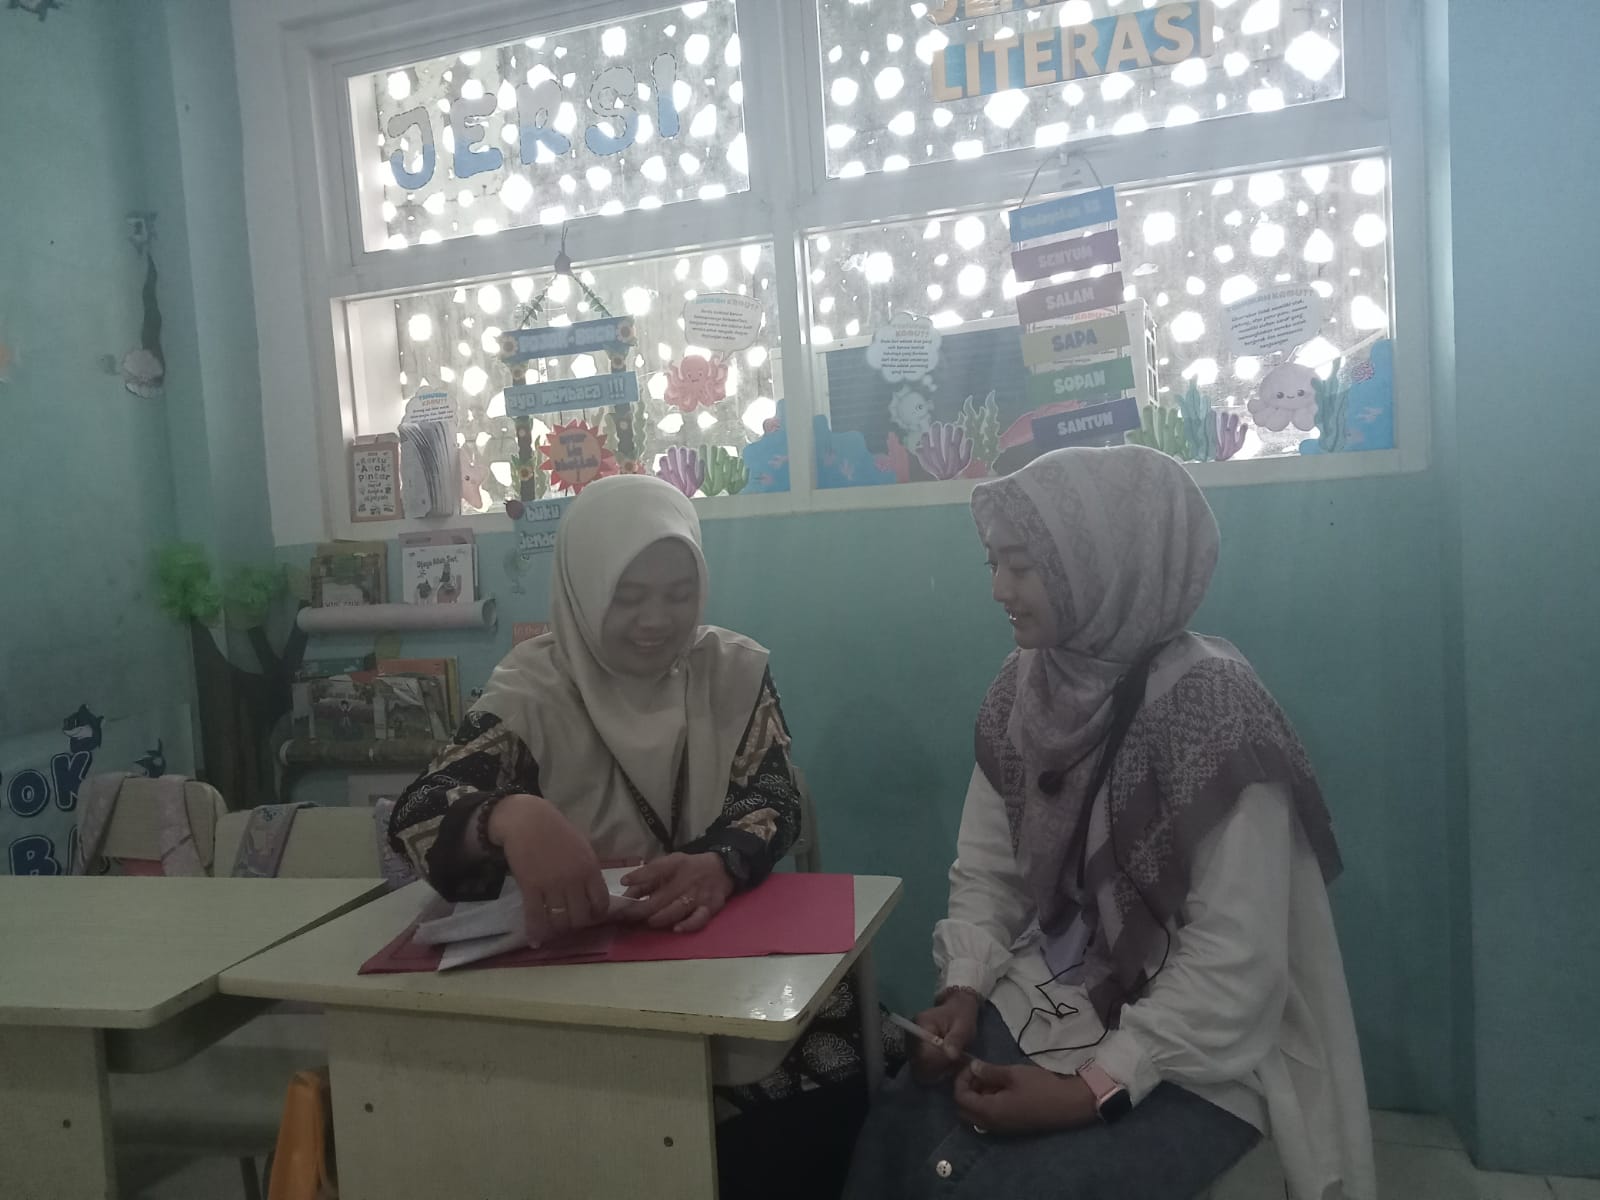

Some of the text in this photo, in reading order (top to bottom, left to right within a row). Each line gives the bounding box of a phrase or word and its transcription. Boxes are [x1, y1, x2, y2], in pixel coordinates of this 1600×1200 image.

[932, 0, 1214, 102] LITERASI
[386, 52, 680, 191] JERSI
[1038, 245, 1093, 268] SENYUM
[1045, 287, 1095, 310] SALAM
[1051, 329, 1098, 352] SAPA
[1053, 370, 1106, 394] SOPAN
[1057, 411, 1114, 436] SANTUN
[0, 750, 93, 817] OK
